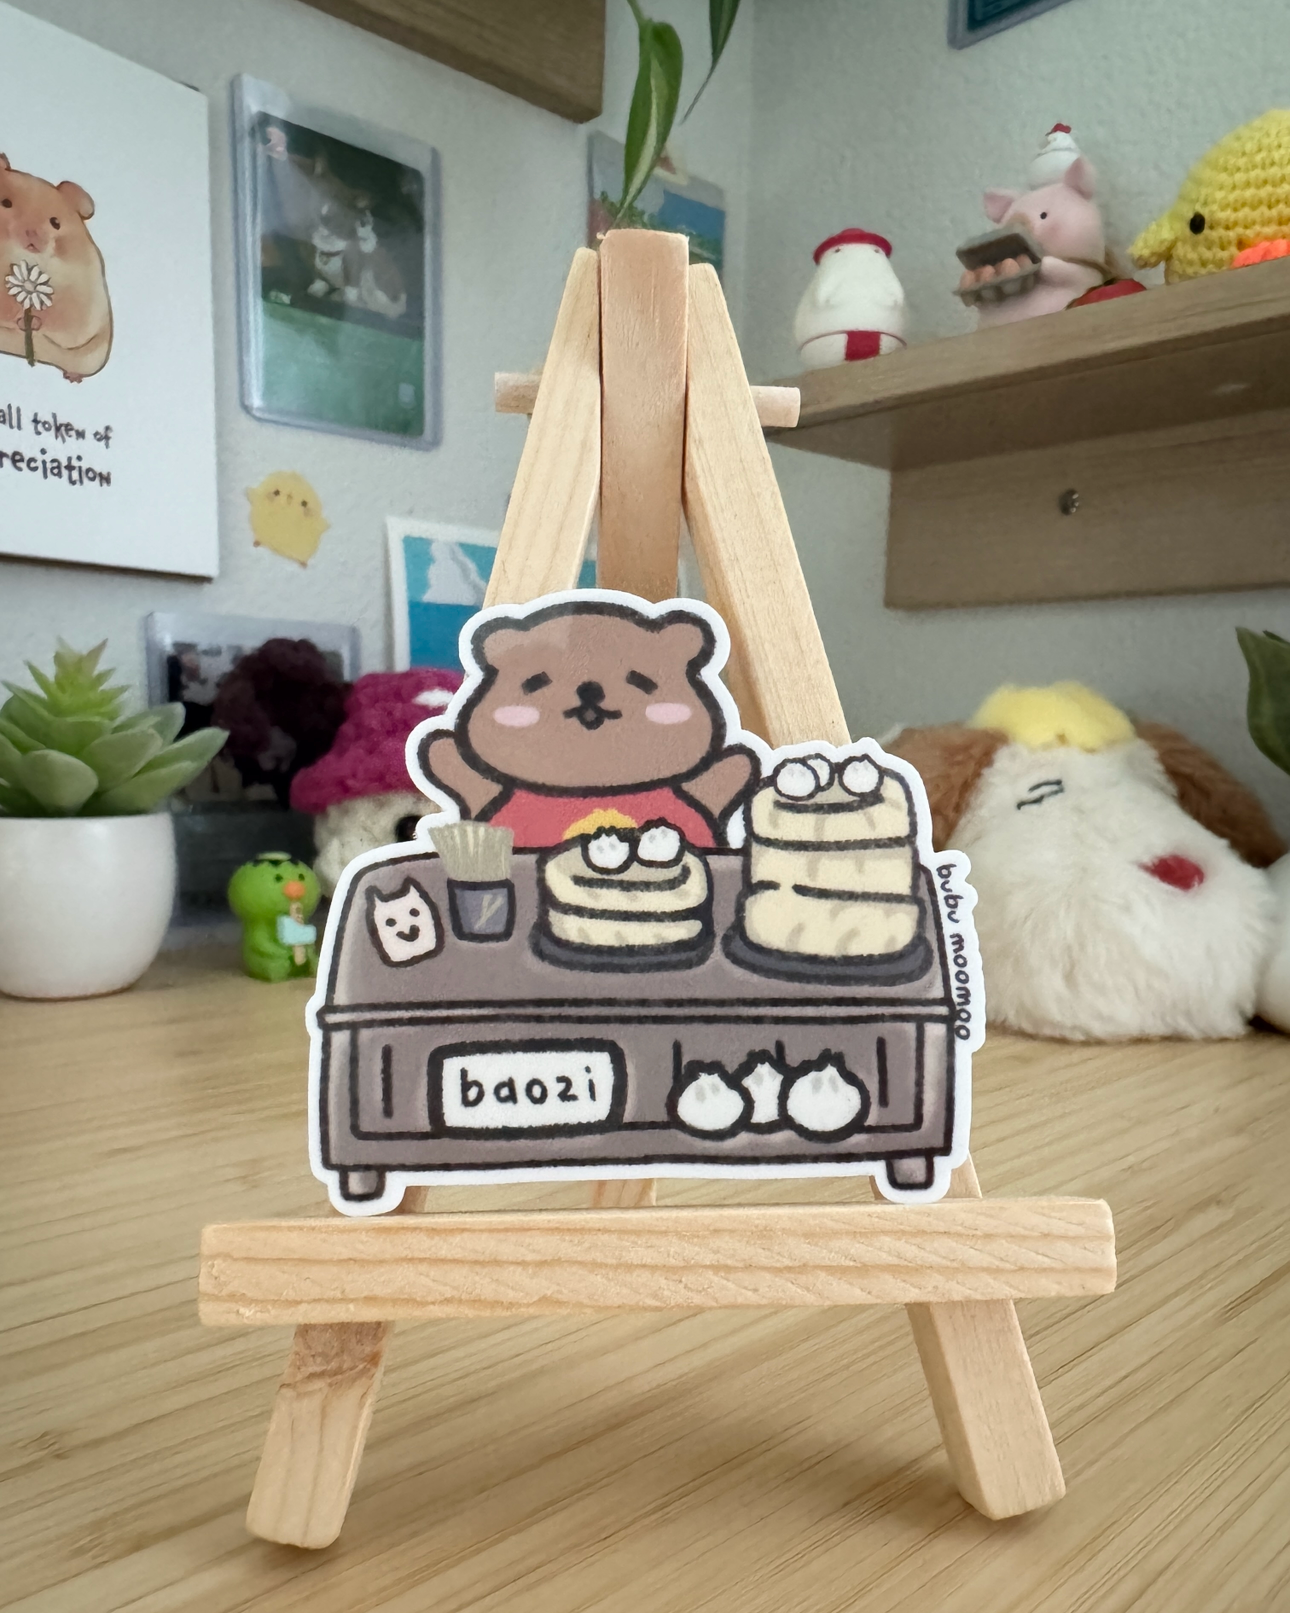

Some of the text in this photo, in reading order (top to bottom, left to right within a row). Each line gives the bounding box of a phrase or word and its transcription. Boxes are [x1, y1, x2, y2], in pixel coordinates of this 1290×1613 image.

[93, 425, 113, 449] of
[936, 863, 972, 1041] bubu moomoo
[460, 1065, 597, 1107] baozi
